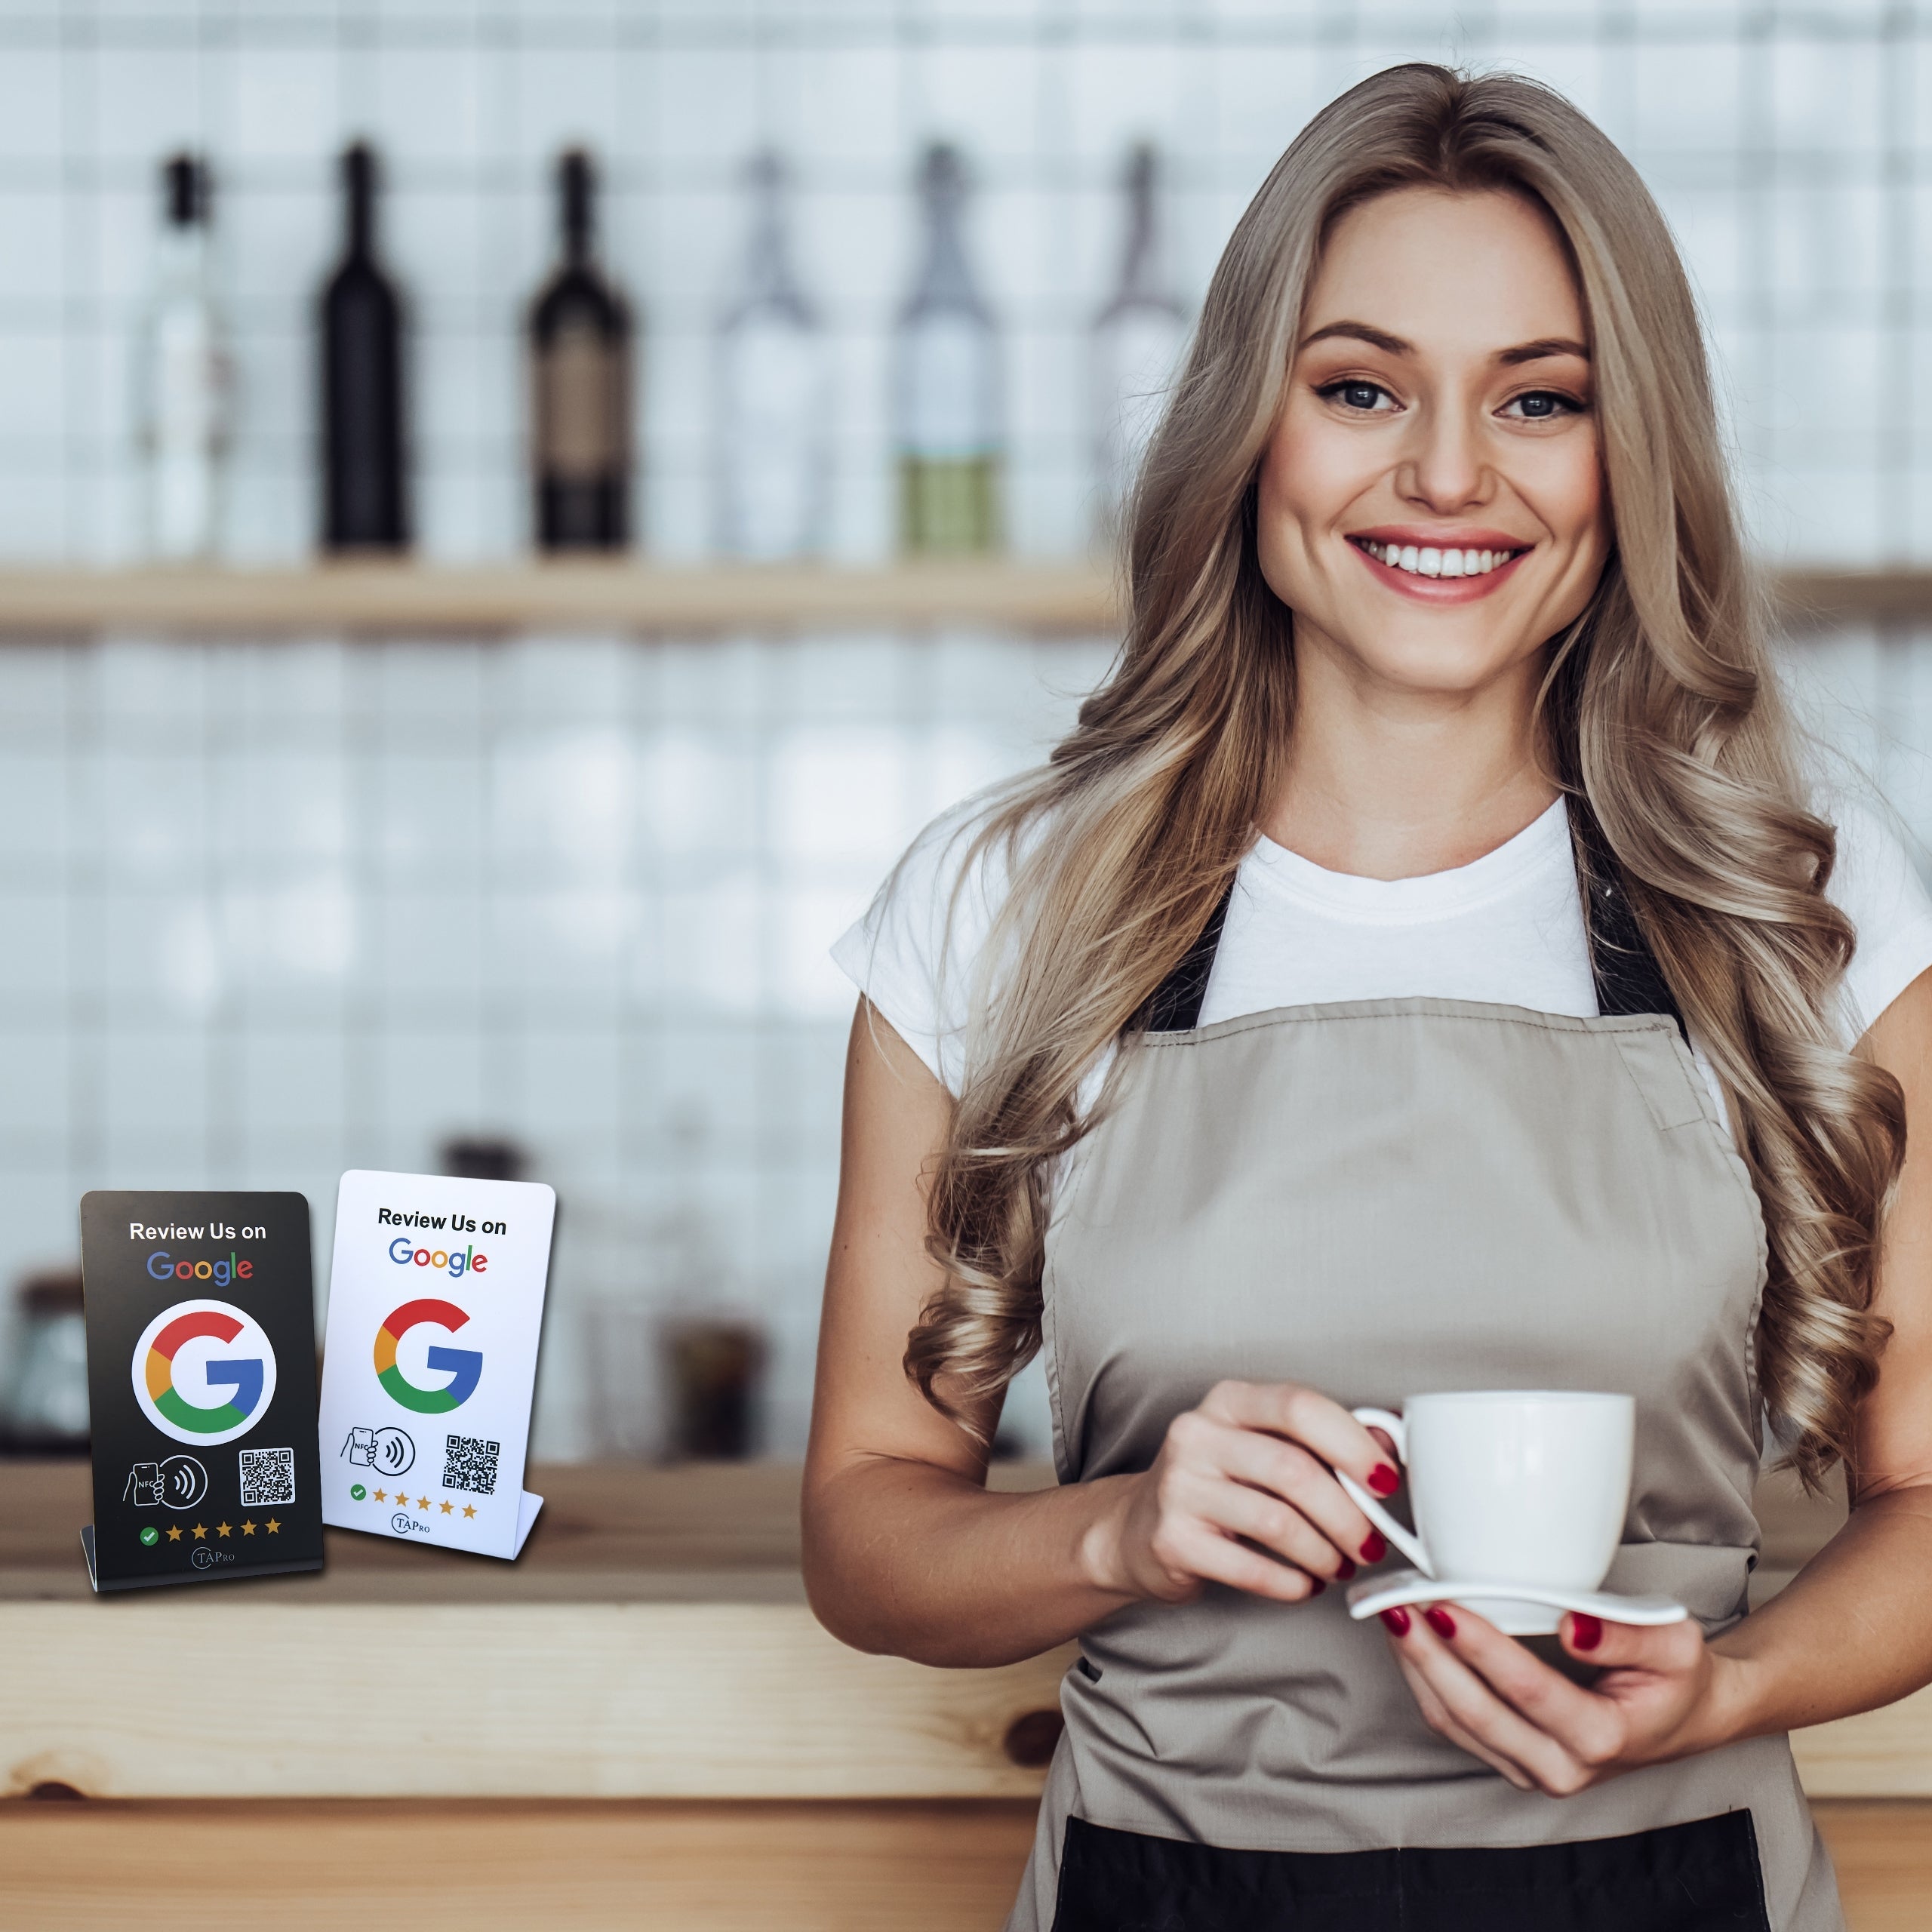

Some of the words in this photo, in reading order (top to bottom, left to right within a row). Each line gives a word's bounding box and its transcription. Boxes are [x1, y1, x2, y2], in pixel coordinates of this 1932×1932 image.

[130, 1223, 205, 1239] Review
[210, 1223, 236, 1239] Us
[242, 1226, 266, 1239] on
[377, 1208, 448, 1229] Review
[451, 1214, 476, 1232] Us
[481, 1220, 506, 1235] on
[146, 1251, 254, 1287] Google
[389, 1237, 488, 1278] Google
[145, 1311, 264, 1434] G
[374, 1298, 483, 1414] G
